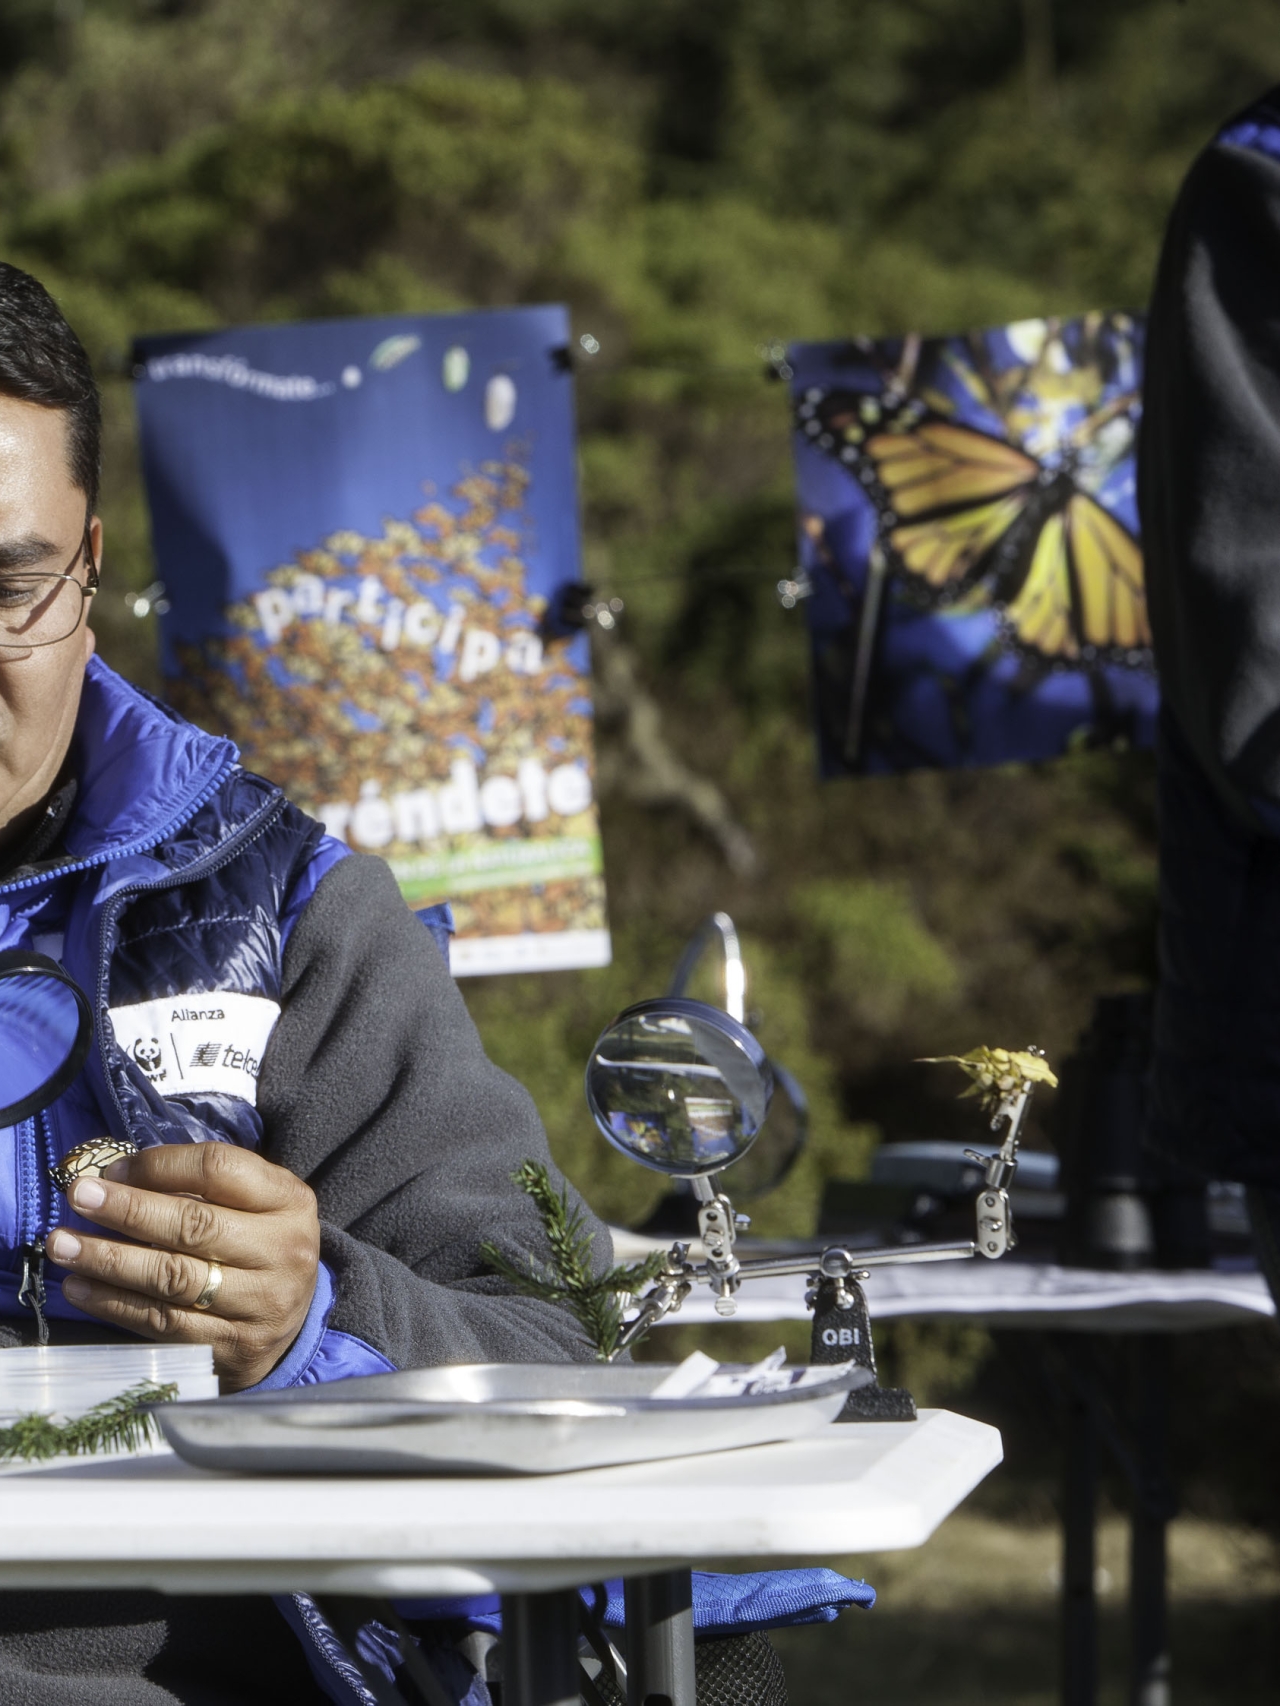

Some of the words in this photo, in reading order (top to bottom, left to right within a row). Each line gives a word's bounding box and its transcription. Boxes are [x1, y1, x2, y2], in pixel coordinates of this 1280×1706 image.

[255, 573, 544, 681] participa
[312, 759, 593, 848] réndete
[170, 1007, 226, 1022] Alianza
